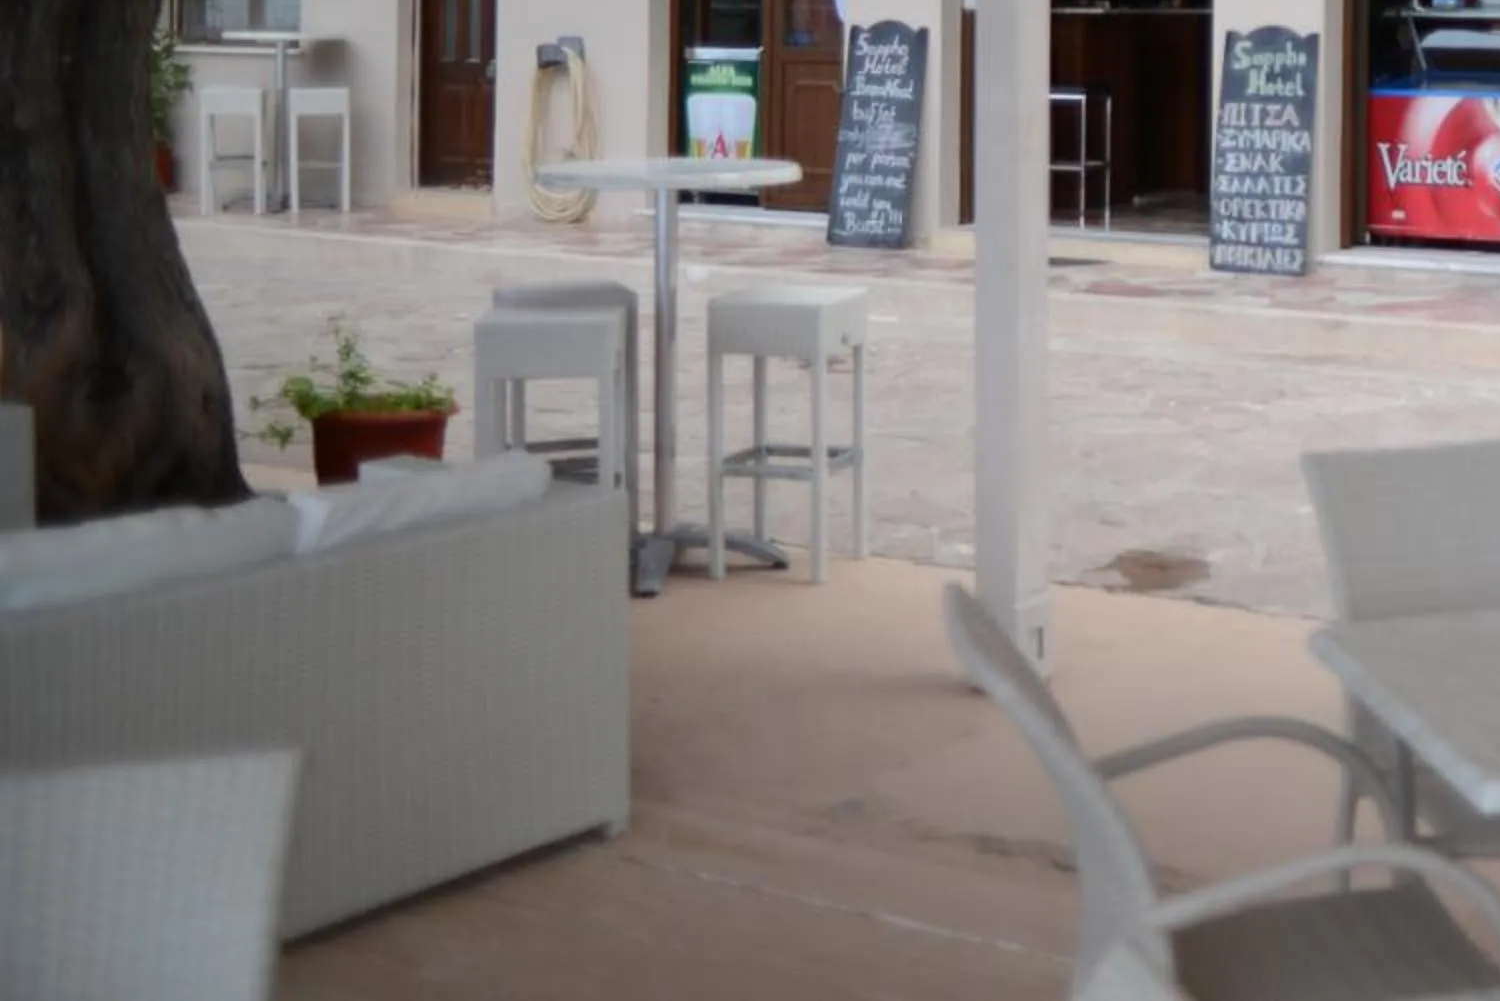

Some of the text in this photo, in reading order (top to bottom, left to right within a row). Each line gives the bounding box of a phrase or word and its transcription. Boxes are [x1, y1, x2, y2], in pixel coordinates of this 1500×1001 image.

[1232, 41, 1307, 72] Sappho
[1245, 68, 1306, 96] Hotel
[1377, 143, 1469, 190] Varieté
